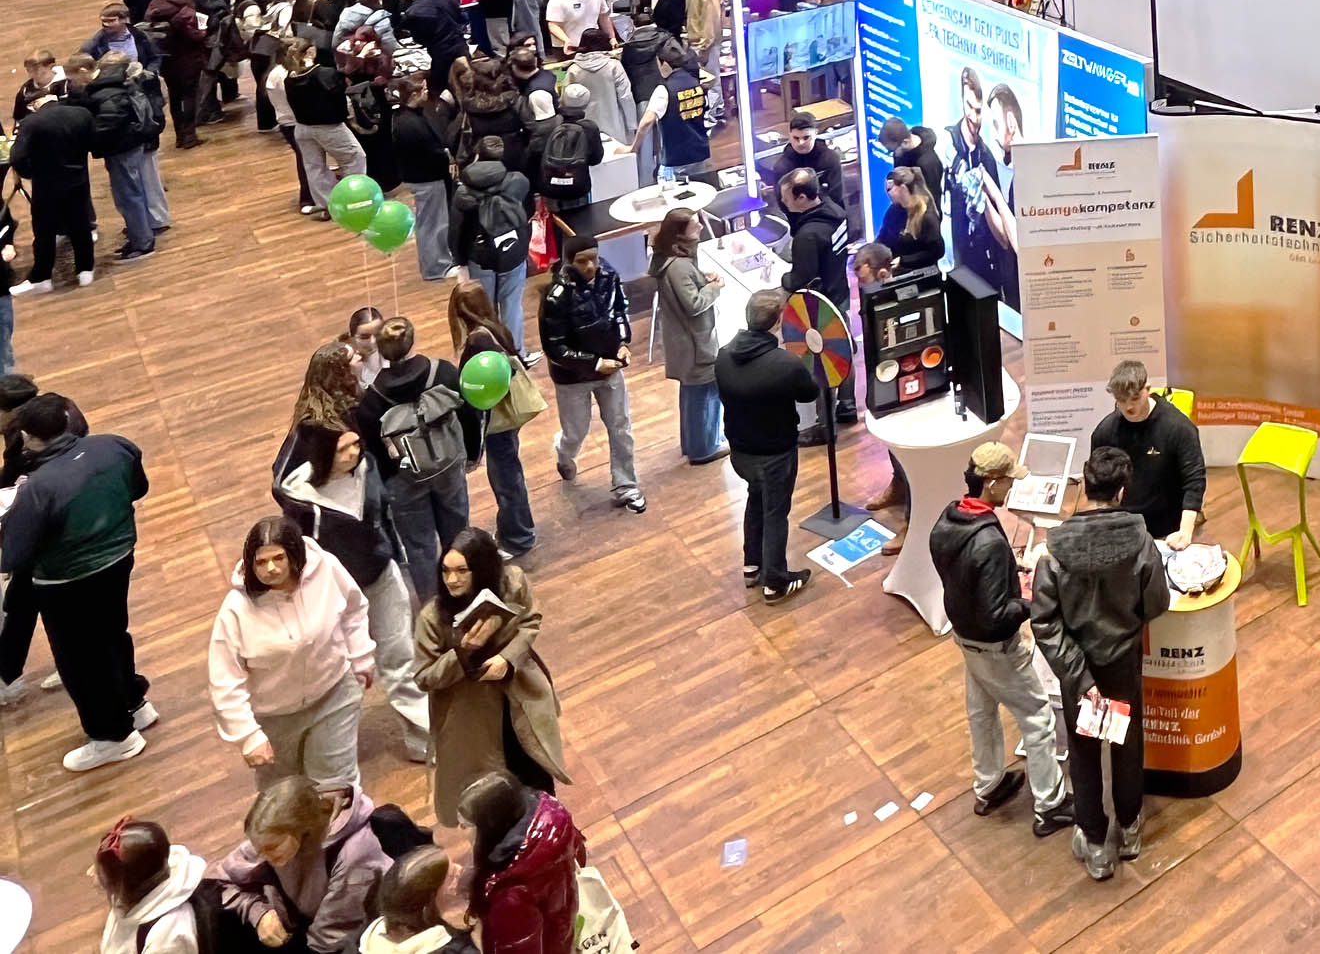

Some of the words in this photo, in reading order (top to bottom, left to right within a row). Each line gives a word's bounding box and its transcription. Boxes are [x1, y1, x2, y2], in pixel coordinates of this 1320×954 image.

[995, 25, 1020, 50] PULS
[1020, 200, 1156, 218] Lösungskompetenz
[1160, 647, 1205, 659] RENZ
